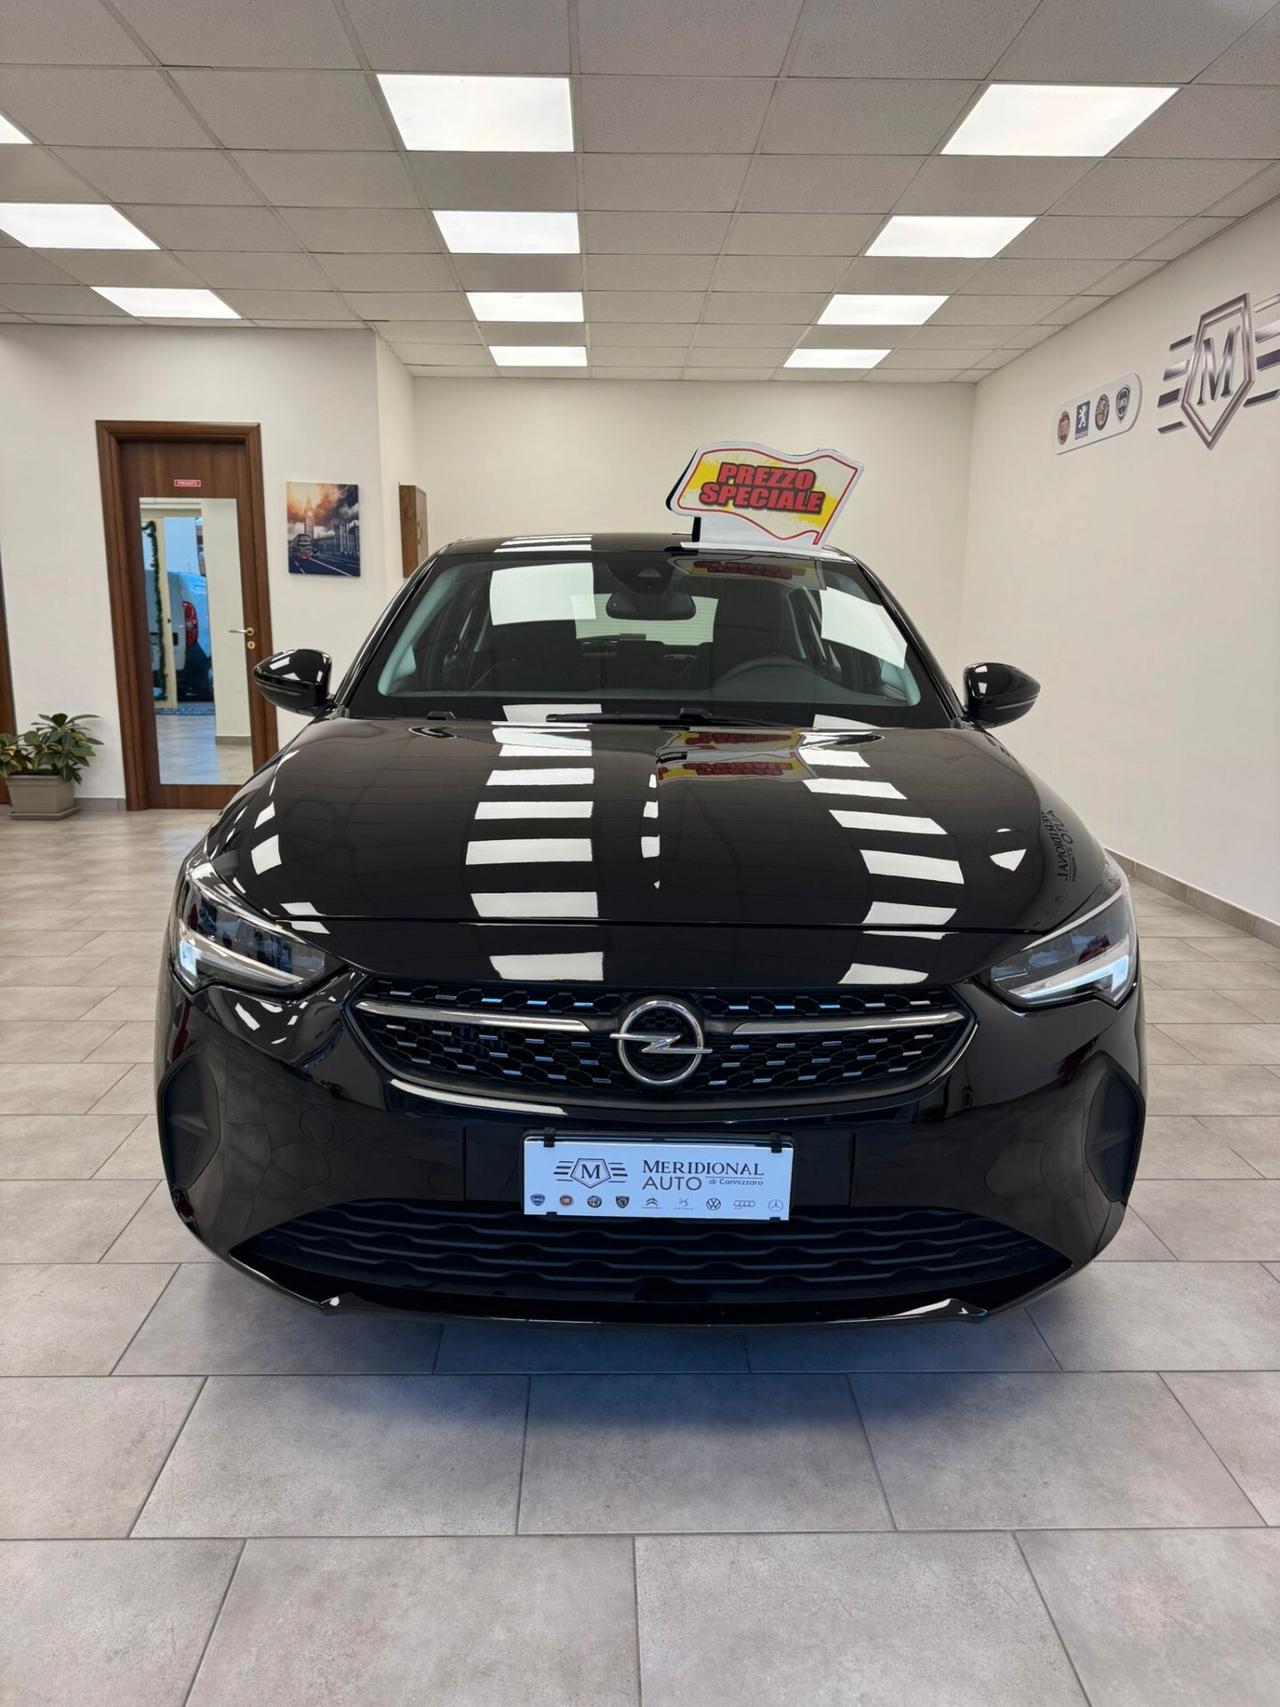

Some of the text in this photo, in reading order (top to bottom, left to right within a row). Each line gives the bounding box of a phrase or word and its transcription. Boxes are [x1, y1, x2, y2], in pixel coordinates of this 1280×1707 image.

[717, 462, 816, 491] PREZZO
[699, 482, 826, 515] SPECIALE
[642, 1159, 765, 1176] MERIDIONAL
[642, 1177, 702, 1191] AUTO
[709, 1178, 764, 1187] di Cannizzaro
